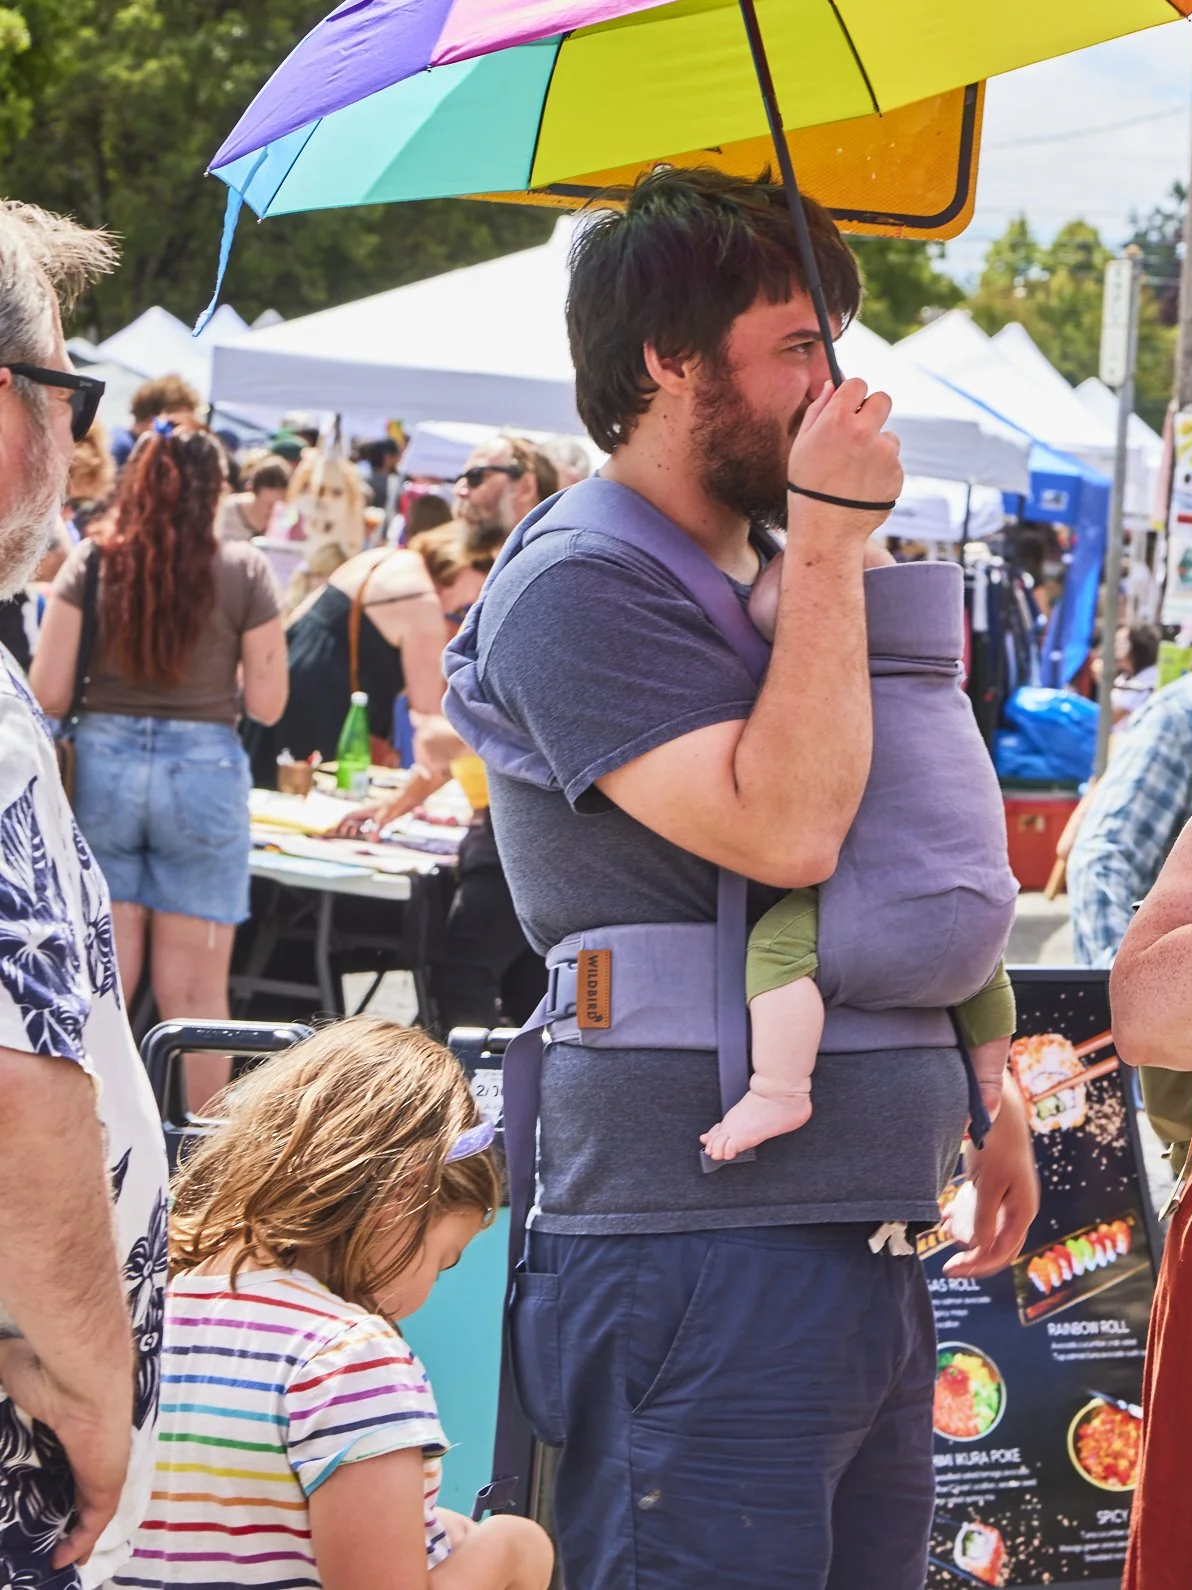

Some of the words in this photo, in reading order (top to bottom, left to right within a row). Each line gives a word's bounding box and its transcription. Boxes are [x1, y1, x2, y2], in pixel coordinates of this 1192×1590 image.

[586, 954, 599, 1020] WILDBIRD
[1047, 1320, 1099, 1336] RAINBOW
[1100, 1318, 1131, 1334] ROLL
[990, 1447, 1022, 1463] POKE
